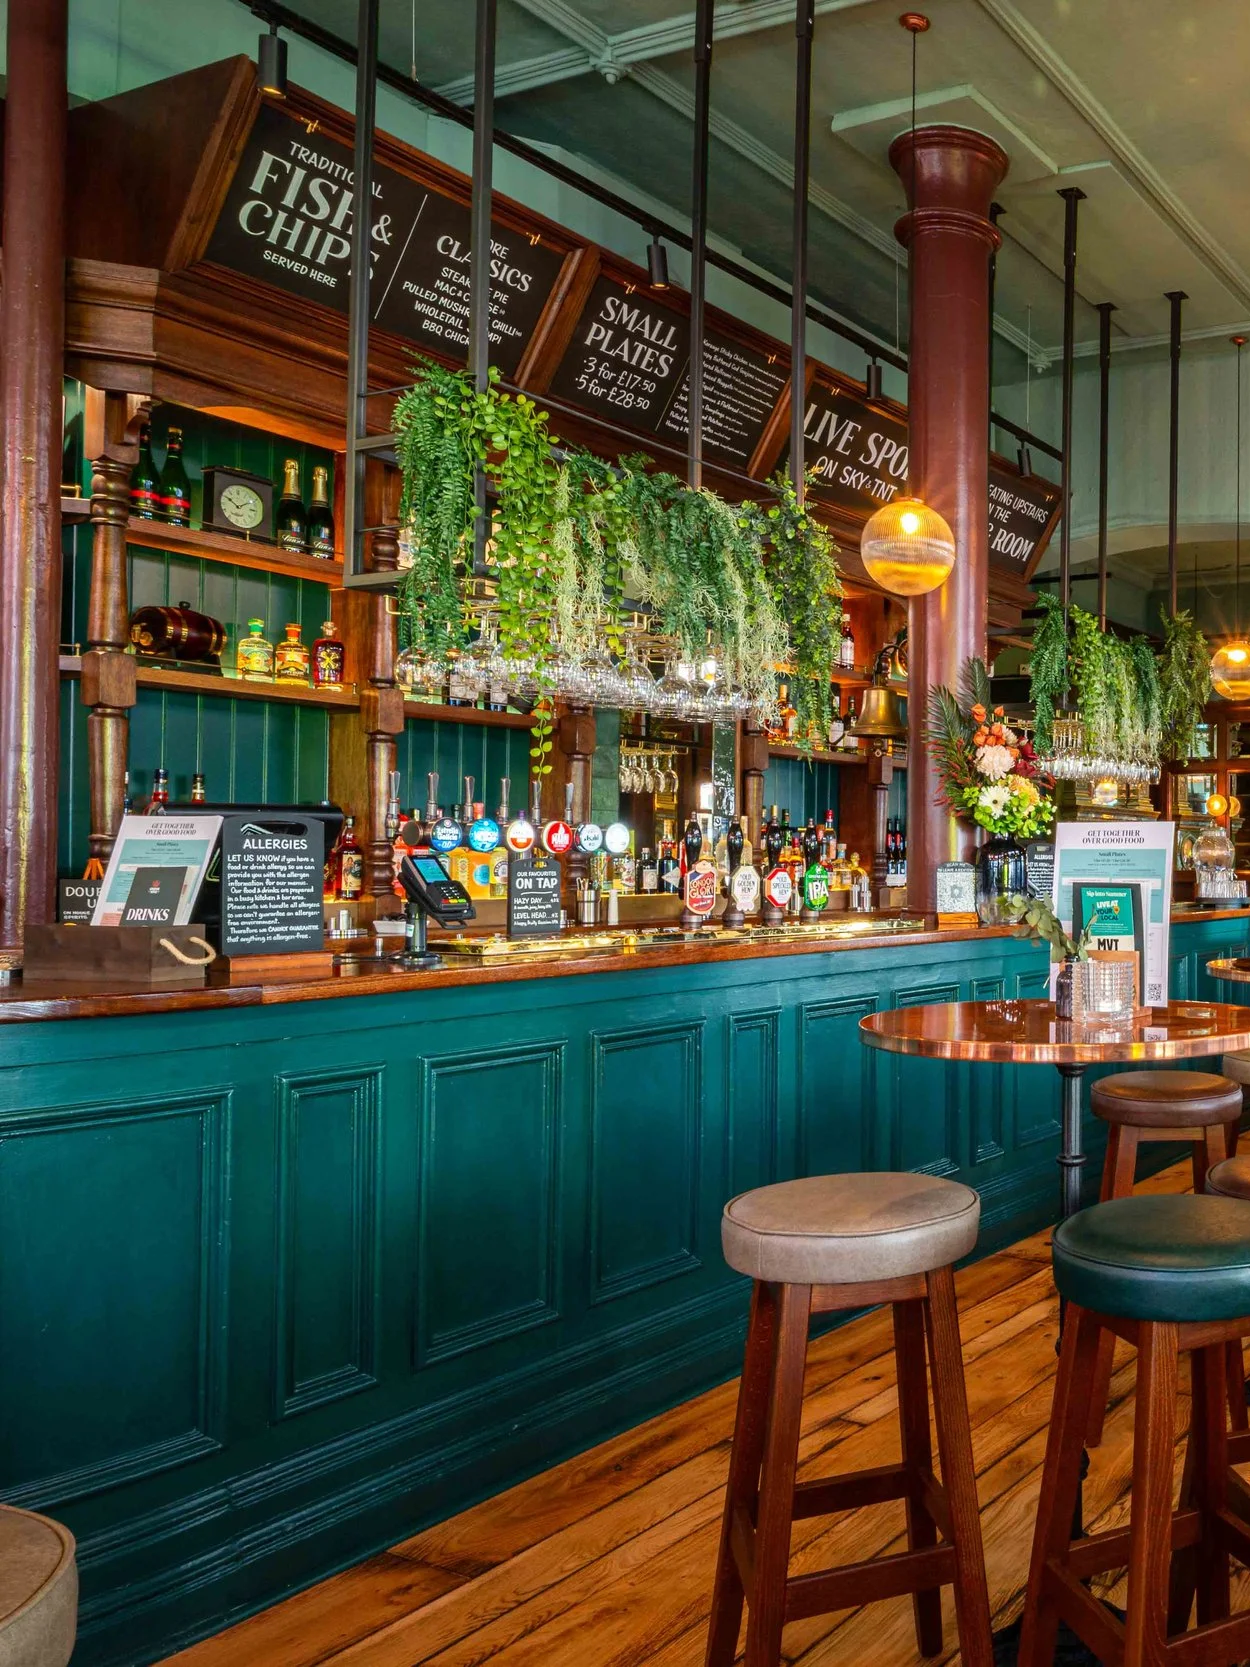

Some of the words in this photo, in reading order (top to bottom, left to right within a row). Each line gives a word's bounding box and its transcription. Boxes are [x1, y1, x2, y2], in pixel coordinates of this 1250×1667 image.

[371, 214, 393, 246] &
[238, 200, 380, 280] CHIP
[263, 250, 309, 277] SERVED
[309, 268, 338, 288] HERE
[434, 280, 457, 296] MAC
[493, 291, 509, 304] PIE
[402, 281, 438, 302] PULLED
[492, 320, 516, 336] CHILLI
[414, 300, 463, 329] WHOLETAIL
[422, 319, 443, 336] BBQ
[600, 296, 677, 351] SMALL
[584, 322, 674, 378] PLATES
[598, 362, 617, 380] for
[587, 379, 607, 397] for
[804, 403, 861, 456] LIVE
[815, 456, 838, 479] ON
[839, 466, 870, 490] SKY
[871, 478, 898, 502] TNT
[994, 506, 1011, 523] THE
[1012, 497, 1048, 523] UPSTAIRS
[991, 528, 1035, 562] ROOM
[243, 839, 308, 850] ALLERGIES
[227, 854, 241, 862] LET
[243, 854, 254, 862] US
[256, 854, 280, 862] KNOW
[227, 872, 250, 880] provide
[286, 871, 310, 880] allergen
[515, 877, 533, 889] ON
[535, 877, 558, 889] TAP
[230, 886, 242, 894] Our
[290, 885, 314, 894] prepared
[240, 894, 254, 903] busy
[808, 880, 829, 900] IPA
[513, 897, 530, 905] HAZY
[126, 908, 170, 921] DRINKS
[1097, 938, 1119, 950] MVT
